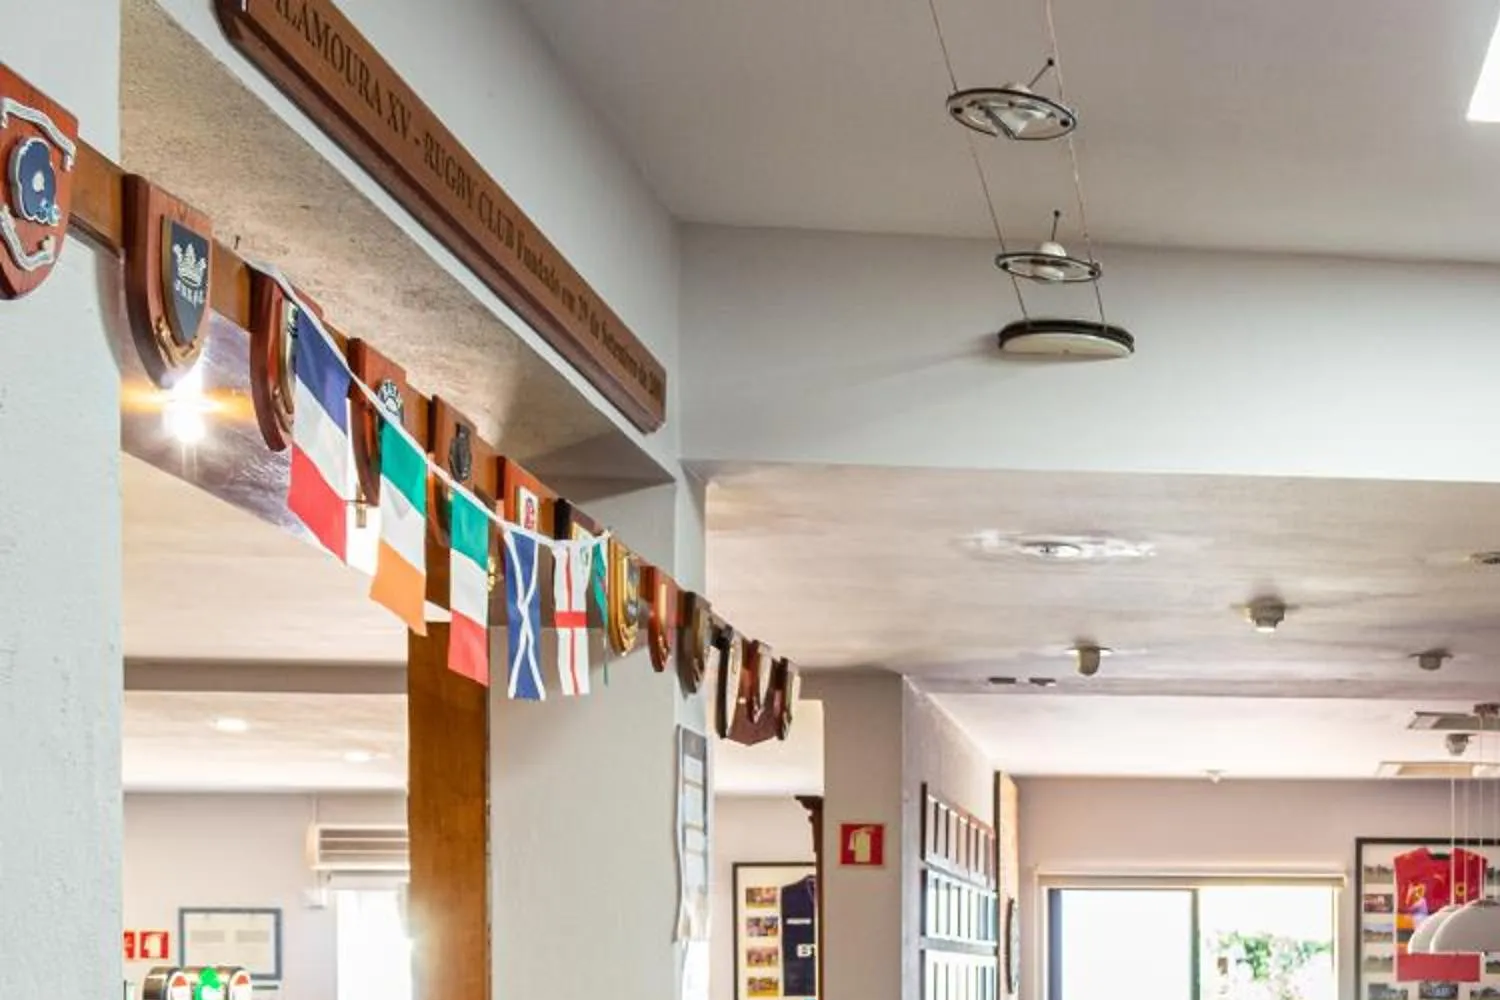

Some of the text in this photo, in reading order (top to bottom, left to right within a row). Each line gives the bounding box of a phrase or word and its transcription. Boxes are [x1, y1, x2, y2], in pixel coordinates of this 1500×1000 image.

[387, 91, 412, 139] XV
[424, 132, 478, 210] RUGBY
[479, 191, 515, 249] CLUB
